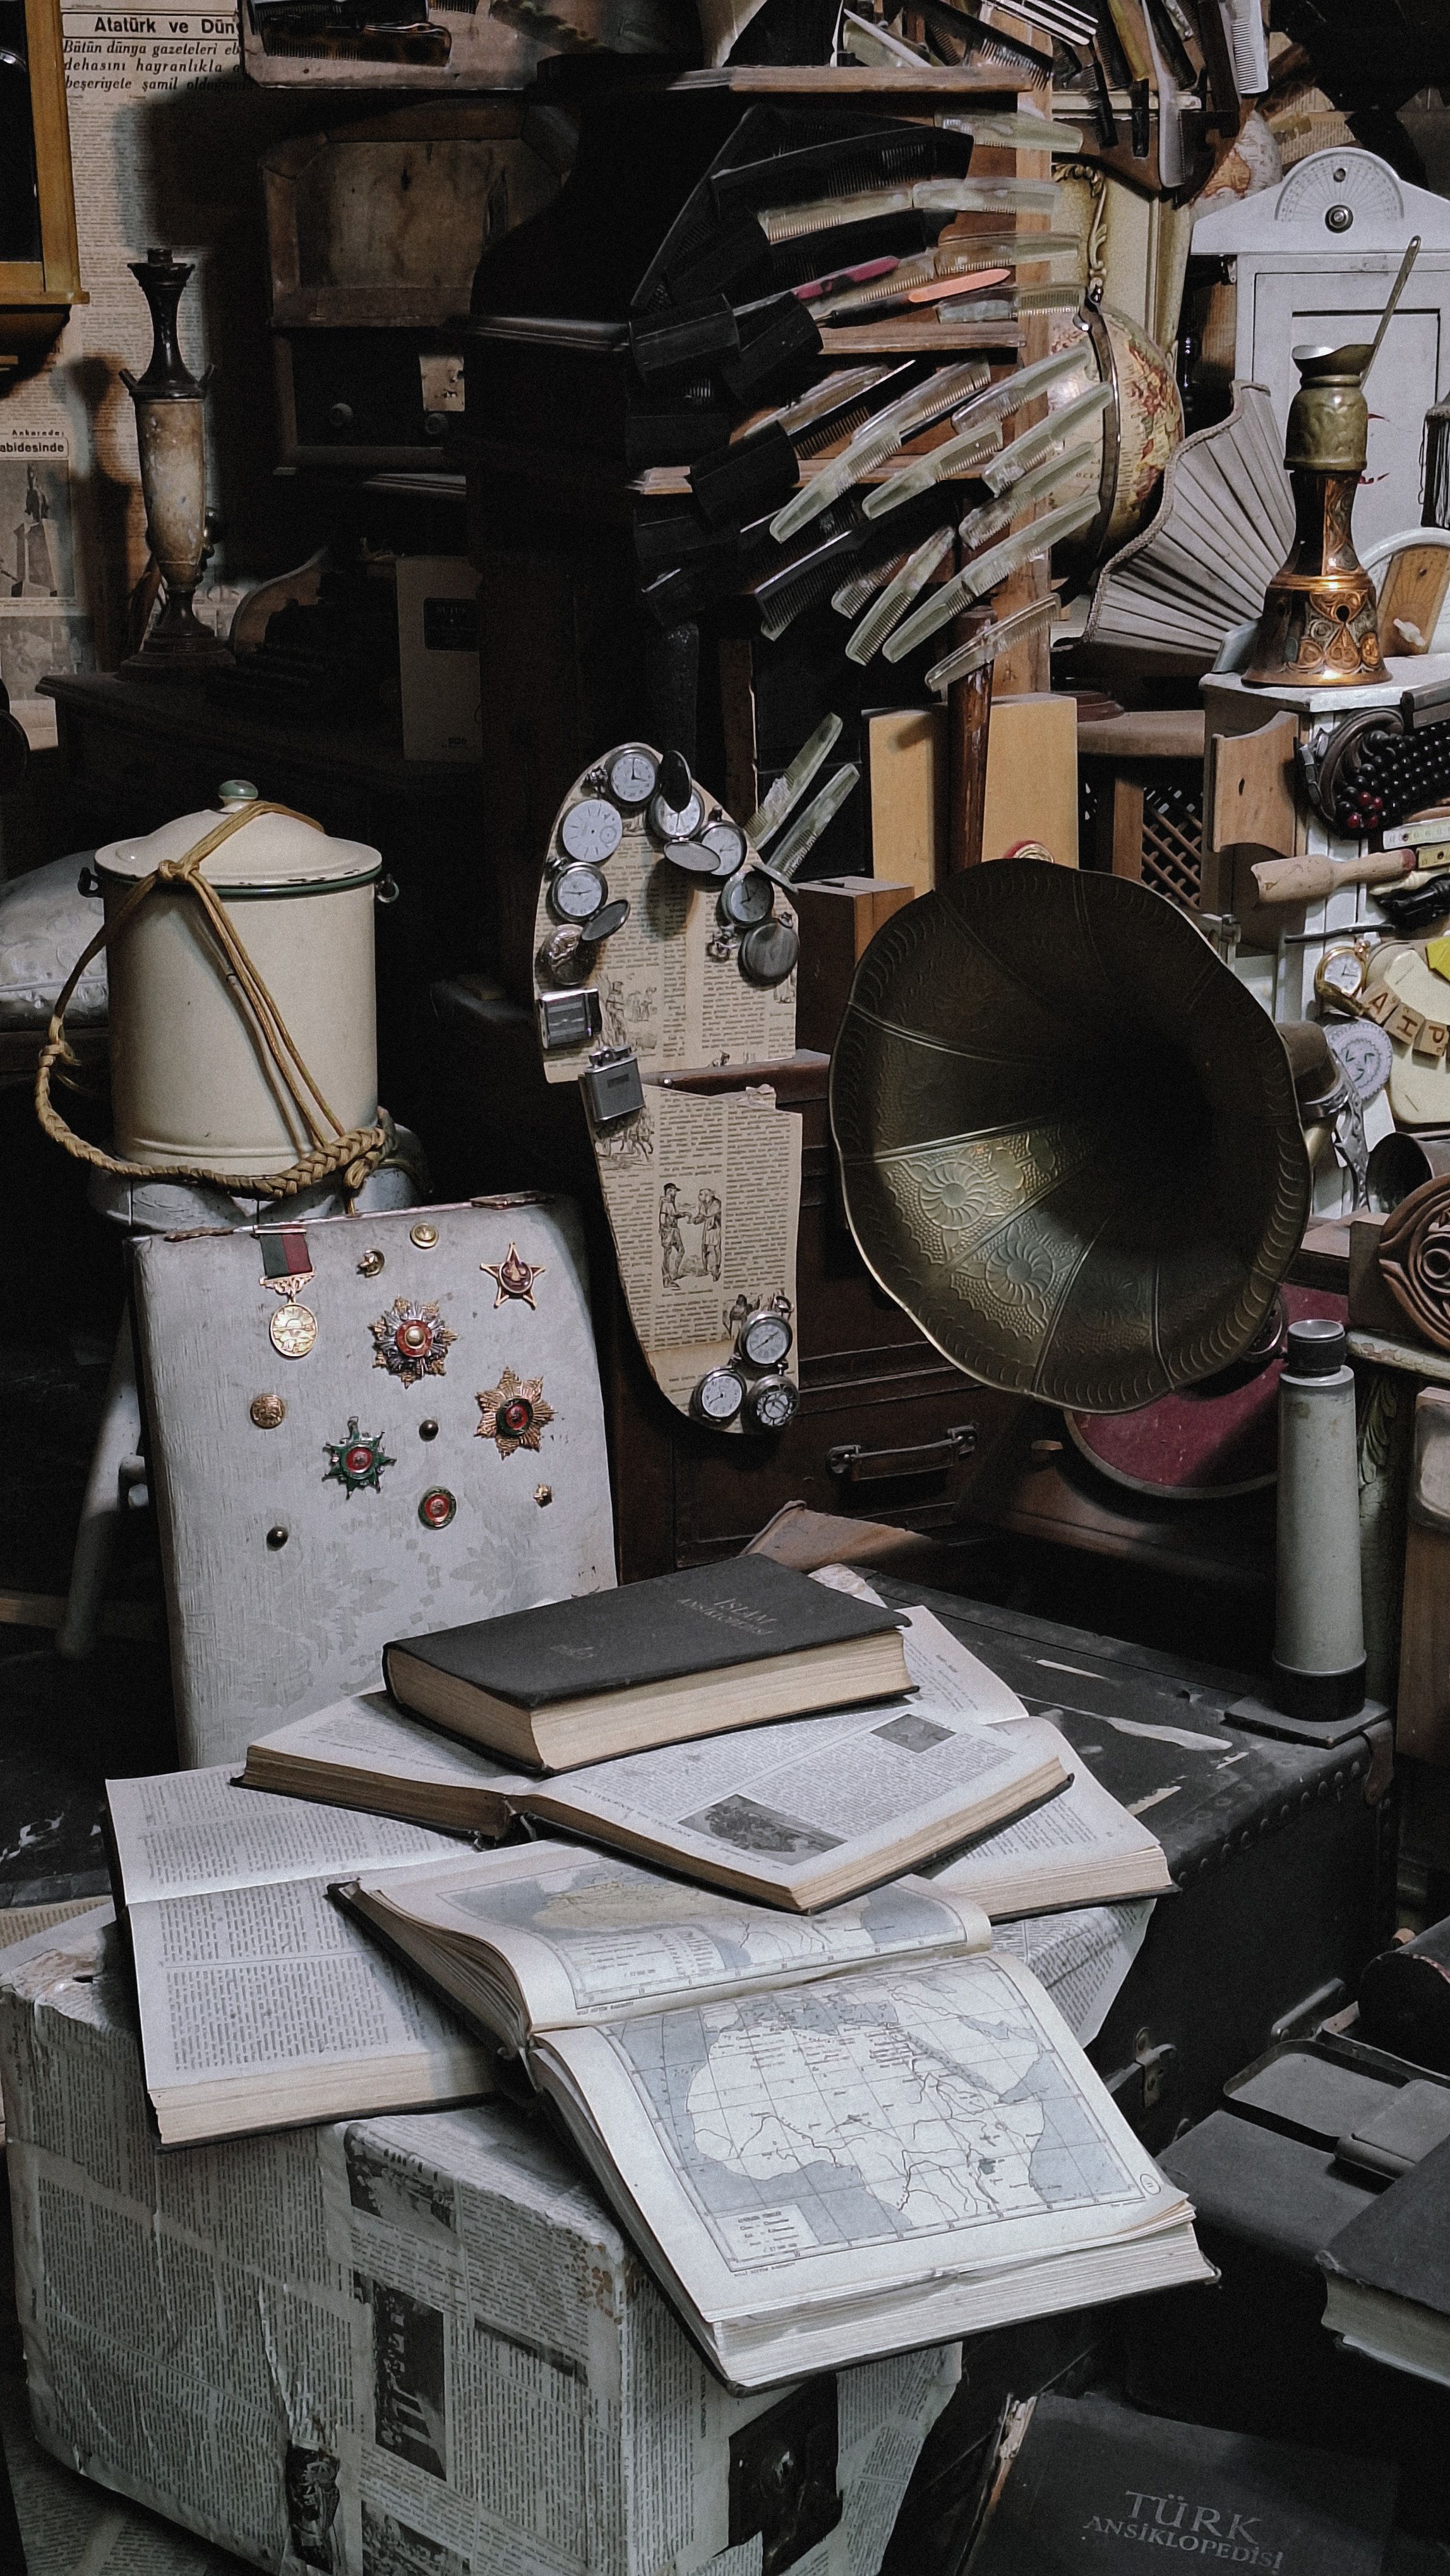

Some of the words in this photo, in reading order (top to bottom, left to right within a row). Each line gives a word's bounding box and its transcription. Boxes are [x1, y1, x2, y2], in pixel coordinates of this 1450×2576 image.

[94, 16, 156, 32] Atatürk
[169, 21, 188, 33] ve
[201, 19, 236, 34] Dün
[63, 39, 102, 54] Bütün
[107, 40, 147, 57] dünya
[152, 42, 217, 57] gazeteleri
[64, 57, 126, 71] dehasını
[136, 57, 222, 75] hayranlıkla
[65, 75, 132, 92] beşeriyete
[141, 76, 178, 92] şamil
[1125, 2490, 1263, 2546] TÜRK
[1082, 2516, 1284, 2570] ANSİKLOPEDİSİ
